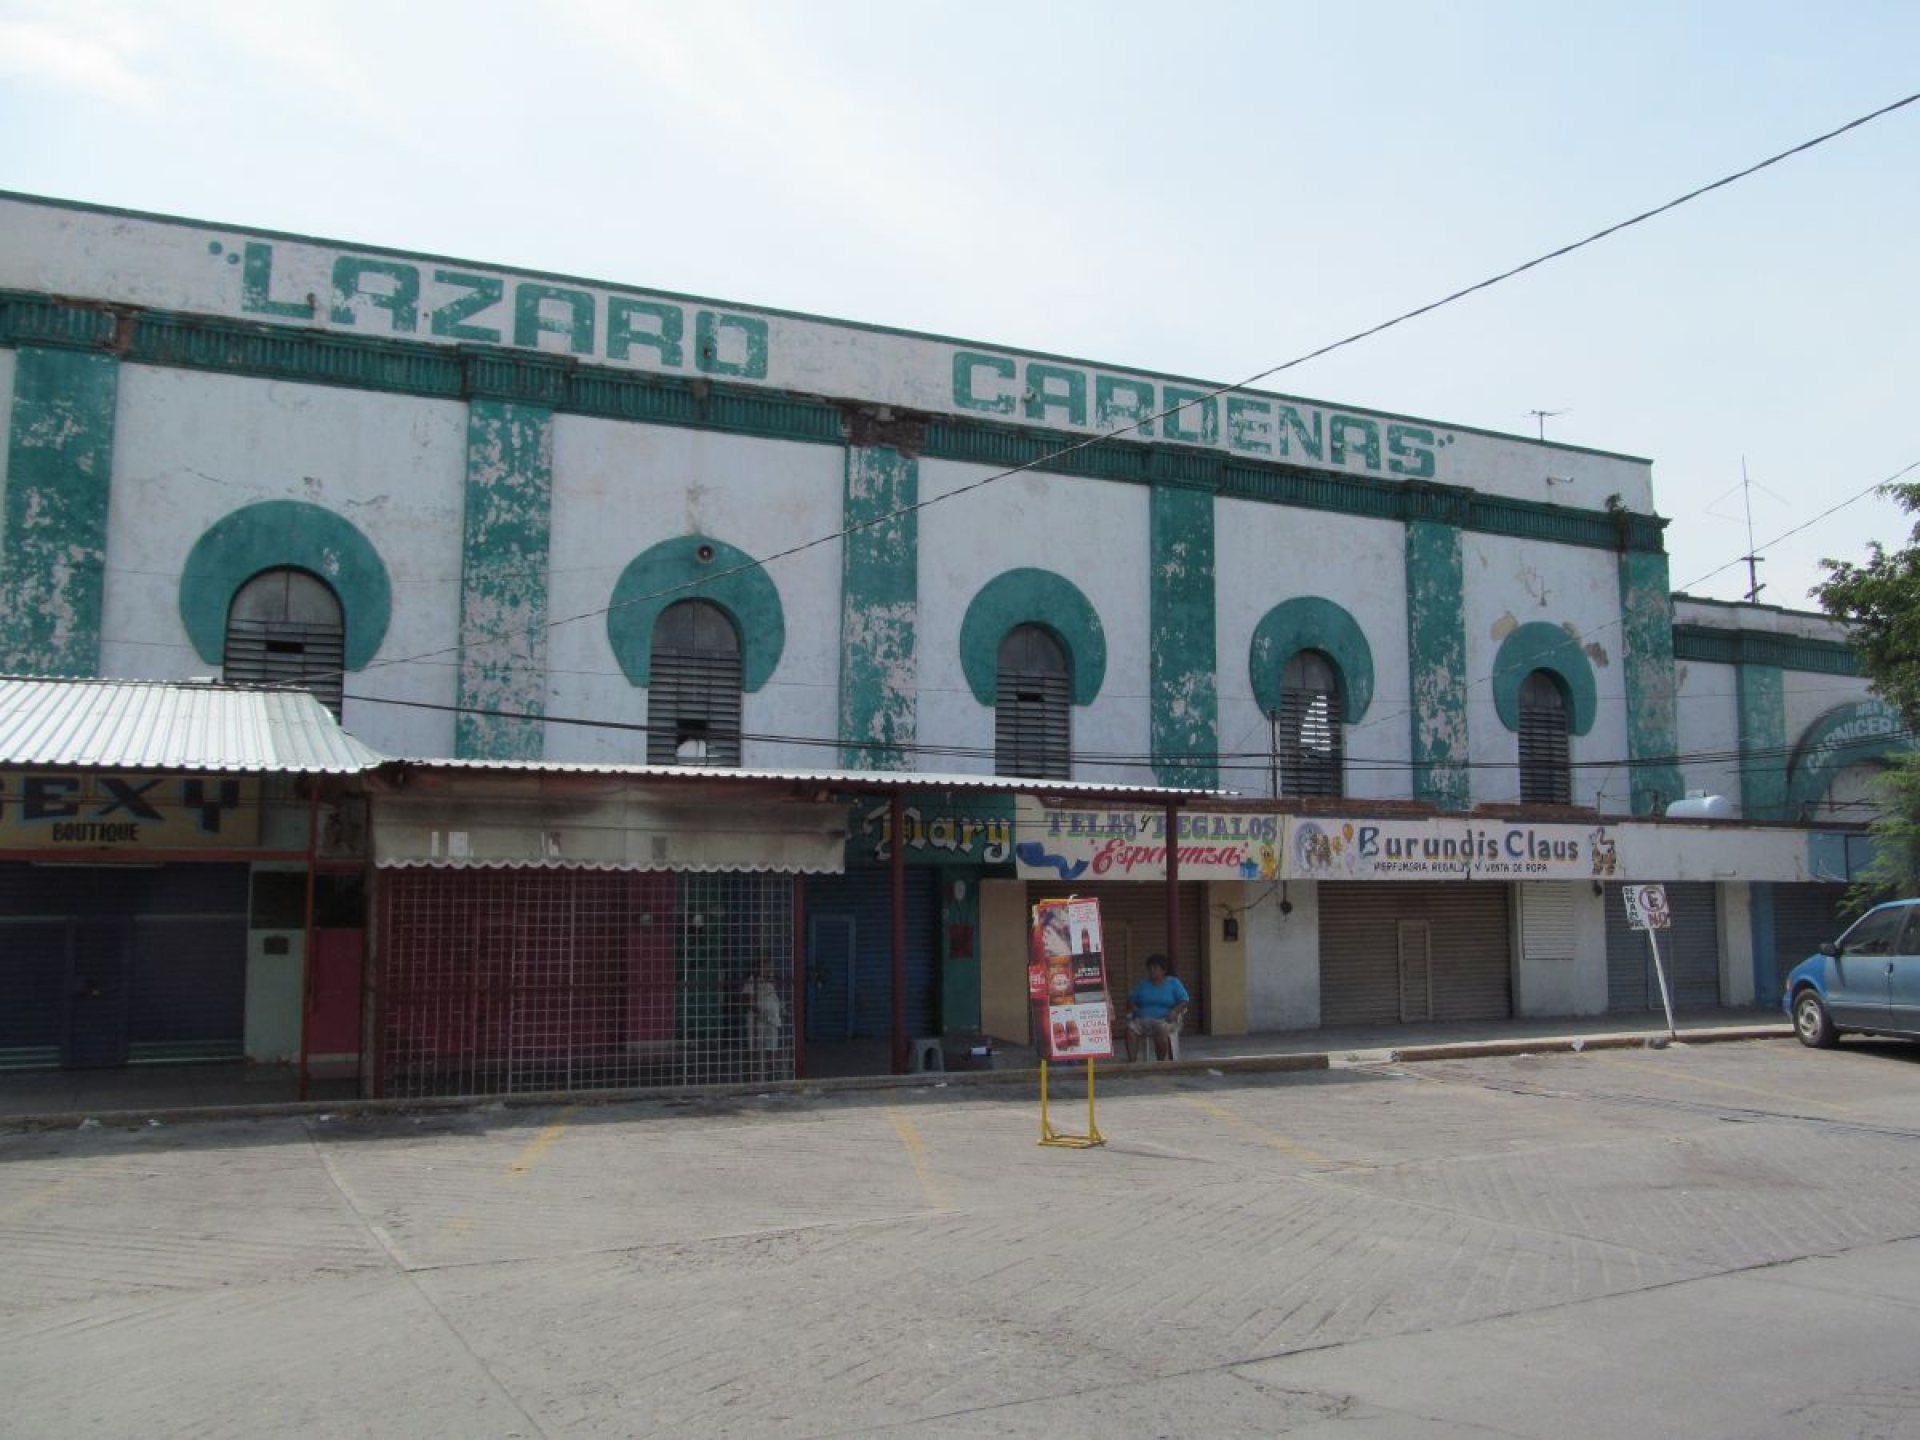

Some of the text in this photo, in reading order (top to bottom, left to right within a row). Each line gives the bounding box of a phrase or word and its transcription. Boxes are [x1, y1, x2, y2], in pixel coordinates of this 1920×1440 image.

[242, 241, 1435, 478] LAZARO CARDENAS
[0, 777, 239, 833] EXY
[53, 823, 140, 842] BOUTIQUE
[1045, 811, 1137, 842] TELAS
[1358, 826, 1580, 862] Burundis Claus
[1092, 837, 1242, 875] Espernza
